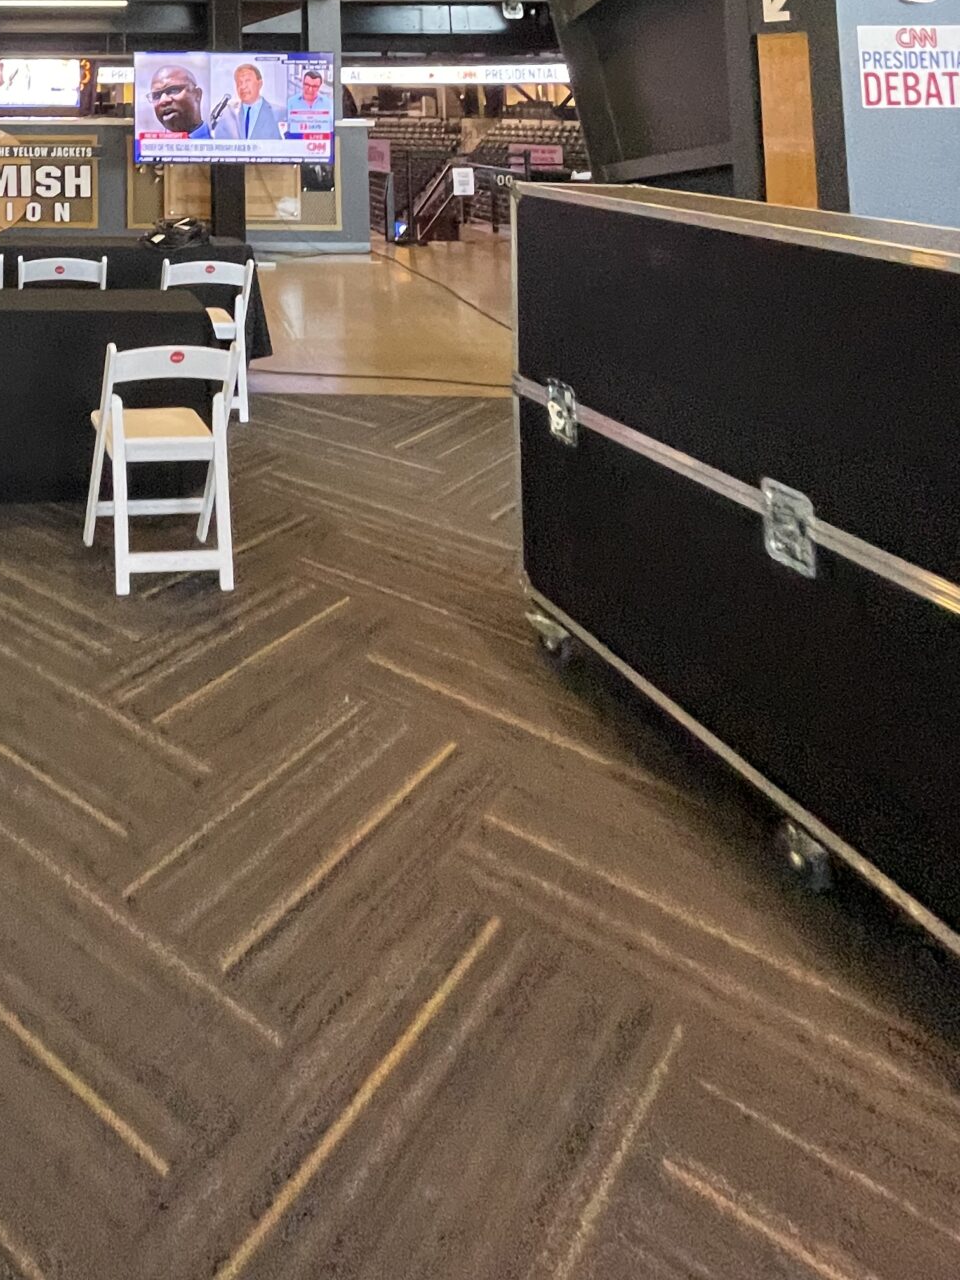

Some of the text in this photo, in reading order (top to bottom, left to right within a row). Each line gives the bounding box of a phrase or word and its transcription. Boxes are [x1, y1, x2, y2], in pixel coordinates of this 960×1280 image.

[895, 27, 937, 49] CNN
[863, 71, 959, 106] DEBAT
[13, 146, 48, 157] YELLOW
[51, 147, 92, 157] JACKETS
